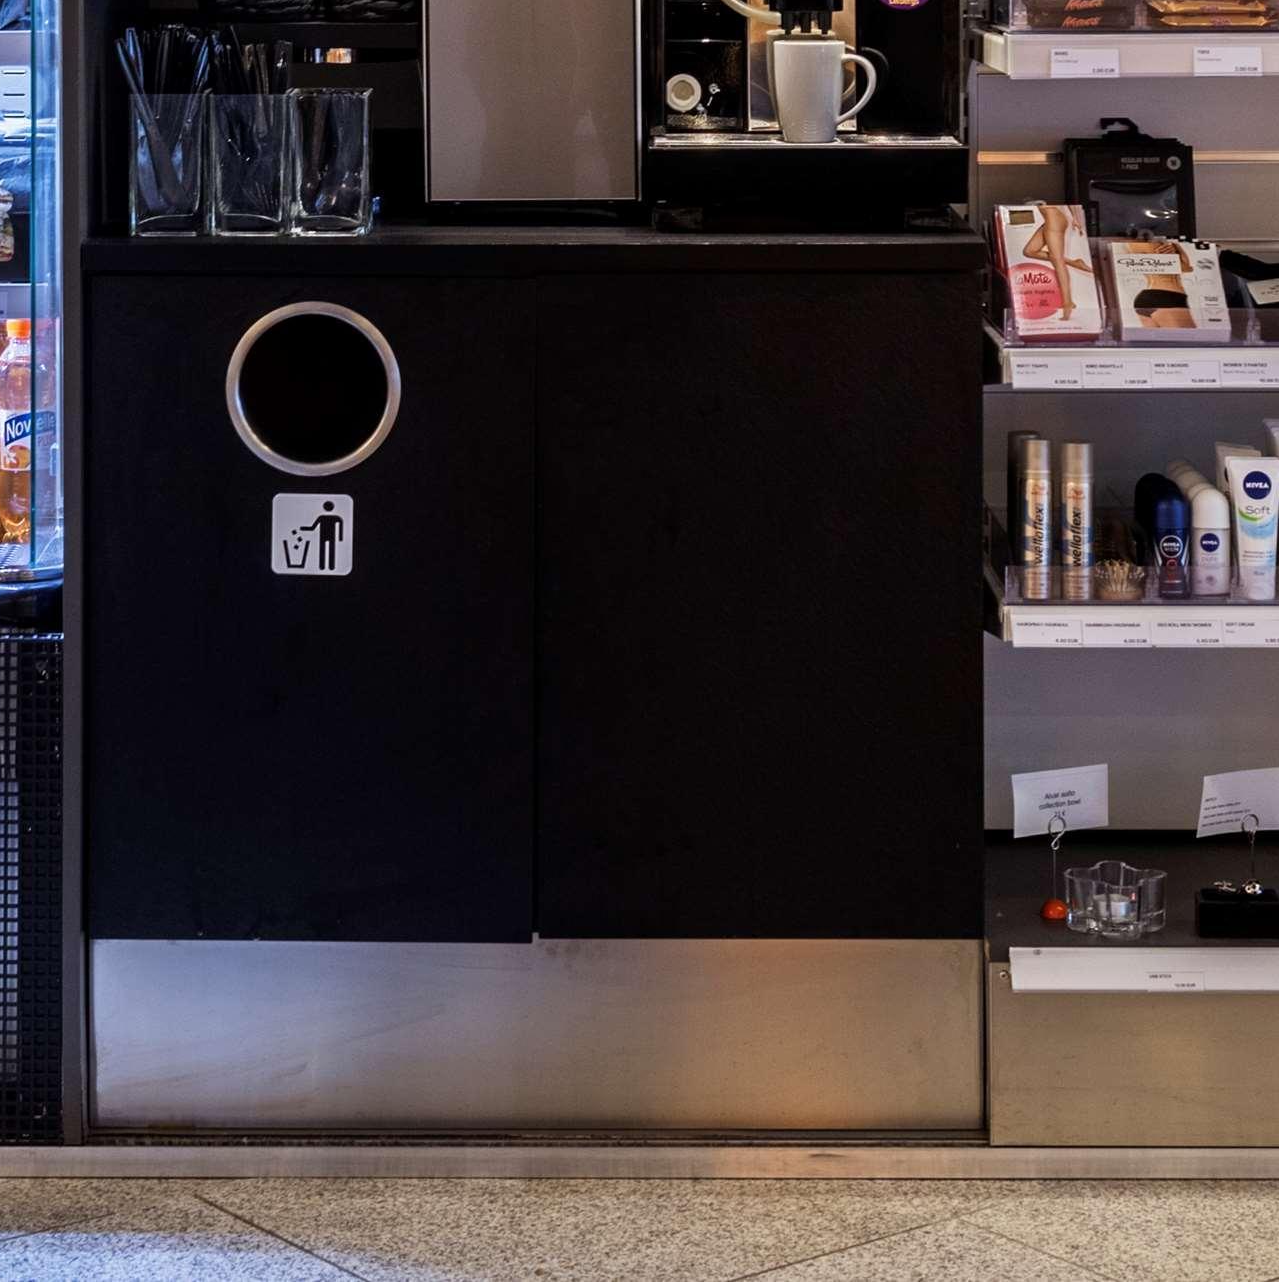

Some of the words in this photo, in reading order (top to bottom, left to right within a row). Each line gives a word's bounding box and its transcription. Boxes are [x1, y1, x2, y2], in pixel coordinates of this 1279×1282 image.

[1245, 481, 1270, 490] NIVEA
[1246, 504, 1272, 517] Soft
[1070, 506, 1082, 569] wellaflex
[1038, 800, 1067, 810] collection
[1066, 797, 1082, 807] bowl
